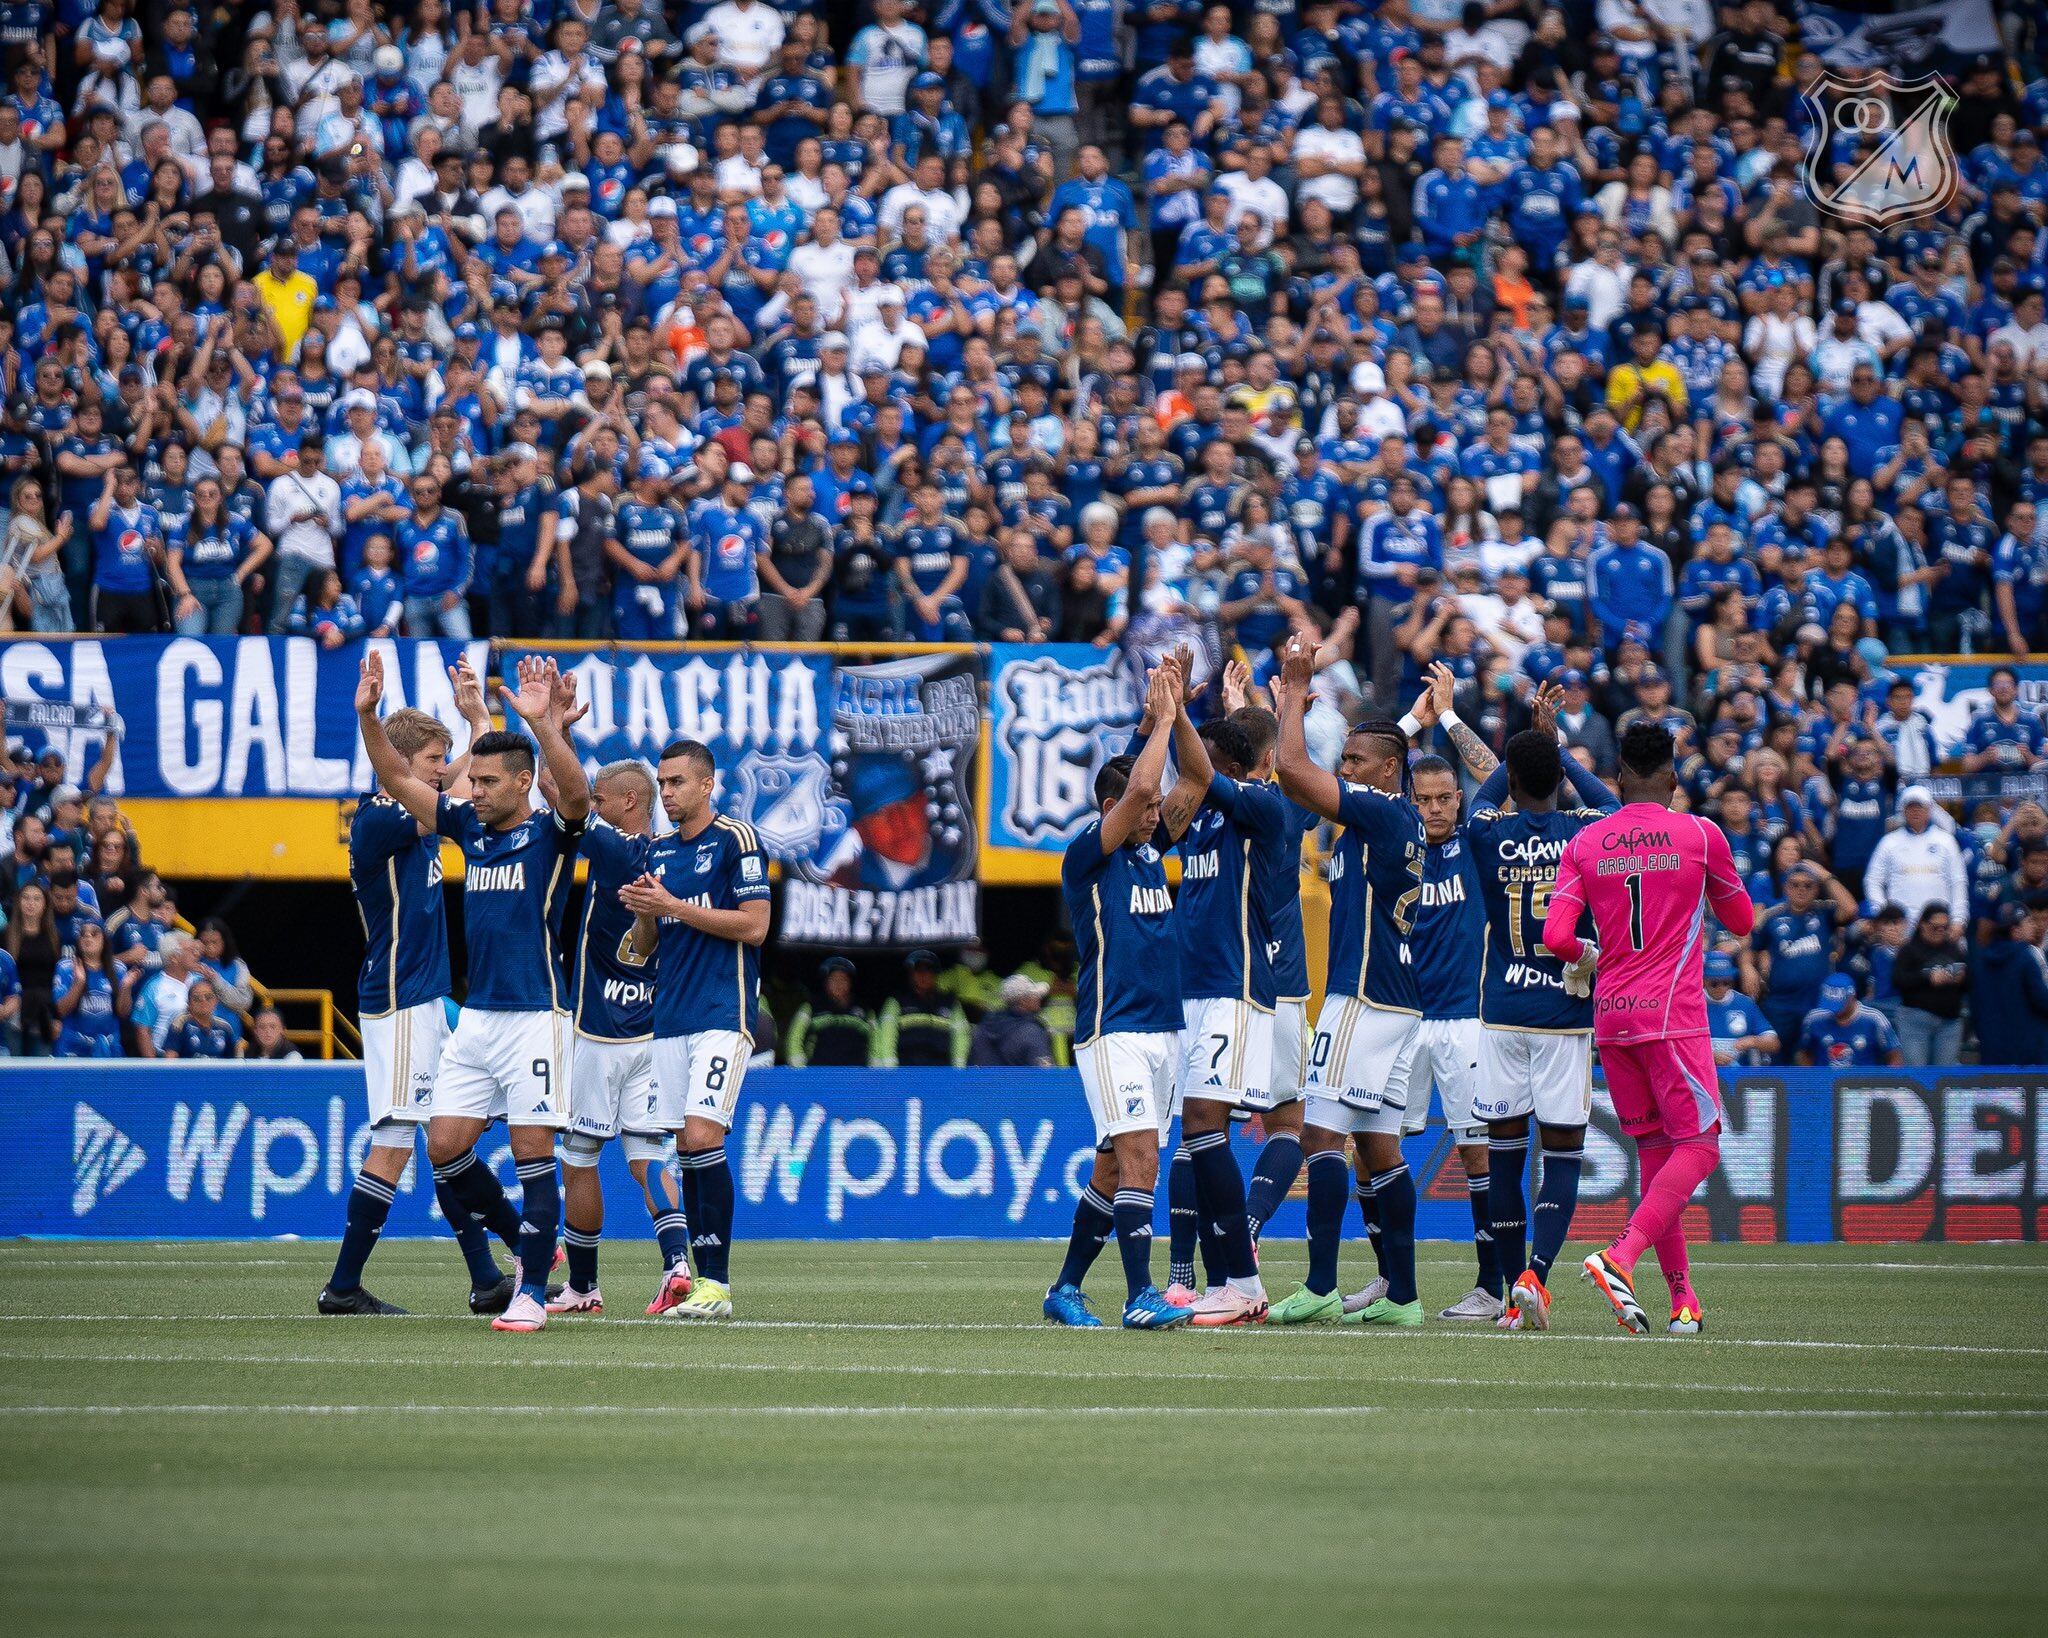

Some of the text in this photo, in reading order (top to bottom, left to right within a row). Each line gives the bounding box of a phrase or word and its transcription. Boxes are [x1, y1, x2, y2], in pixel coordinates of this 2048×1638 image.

[516, 652, 821, 750] OACHA
[1184, 849, 1218, 880] DINA
[1498, 865, 1560, 882] CORDO
[1597, 853, 1680, 876] ARBOLEDA
[1624, 873, 1644, 951] 1
[1211, 1033, 1229, 1069] 7
[532, 1058, 550, 1095] 9
[706, 1056, 728, 1091] 8
[578, 1116, 611, 1132] Allianz
